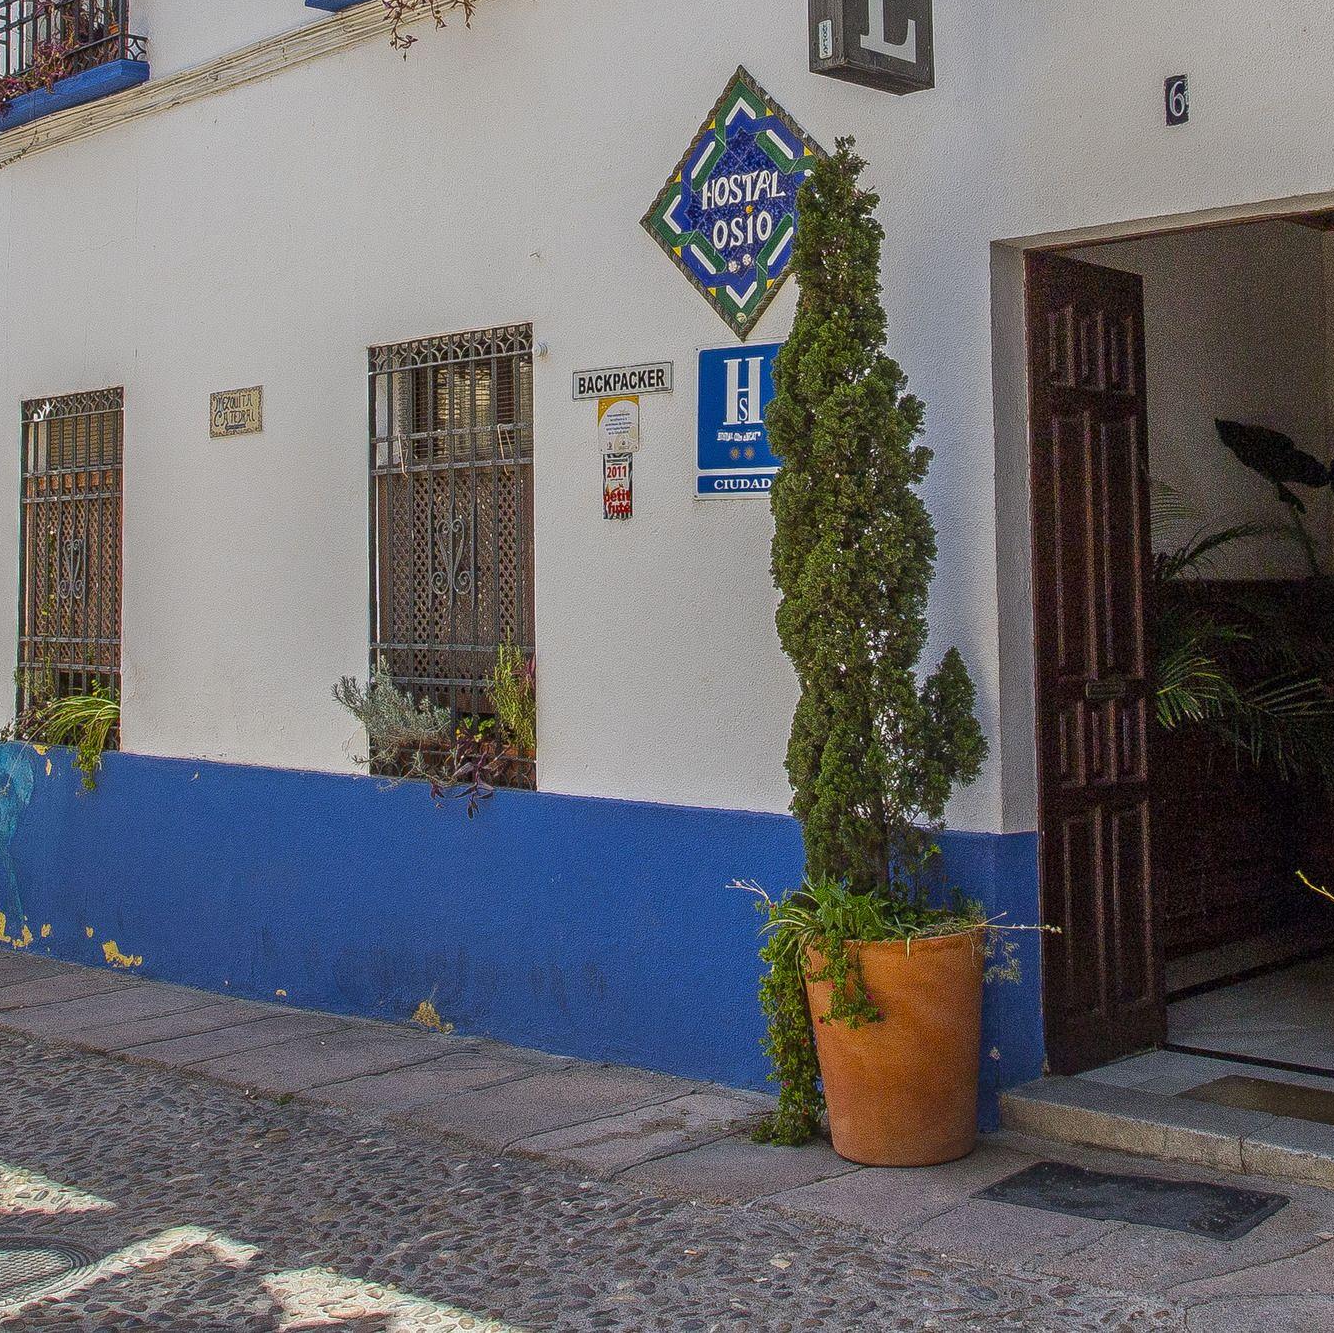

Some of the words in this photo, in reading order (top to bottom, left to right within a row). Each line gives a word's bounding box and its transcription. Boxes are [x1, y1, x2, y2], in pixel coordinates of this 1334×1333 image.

[1169, 81, 1185, 116] 6
[701, 169, 786, 210] HOSTAL
[578, 368, 665, 394] BACKPACKER
[607, 466, 627, 478] 2011
[714, 478, 772, 490] CIUDAD
